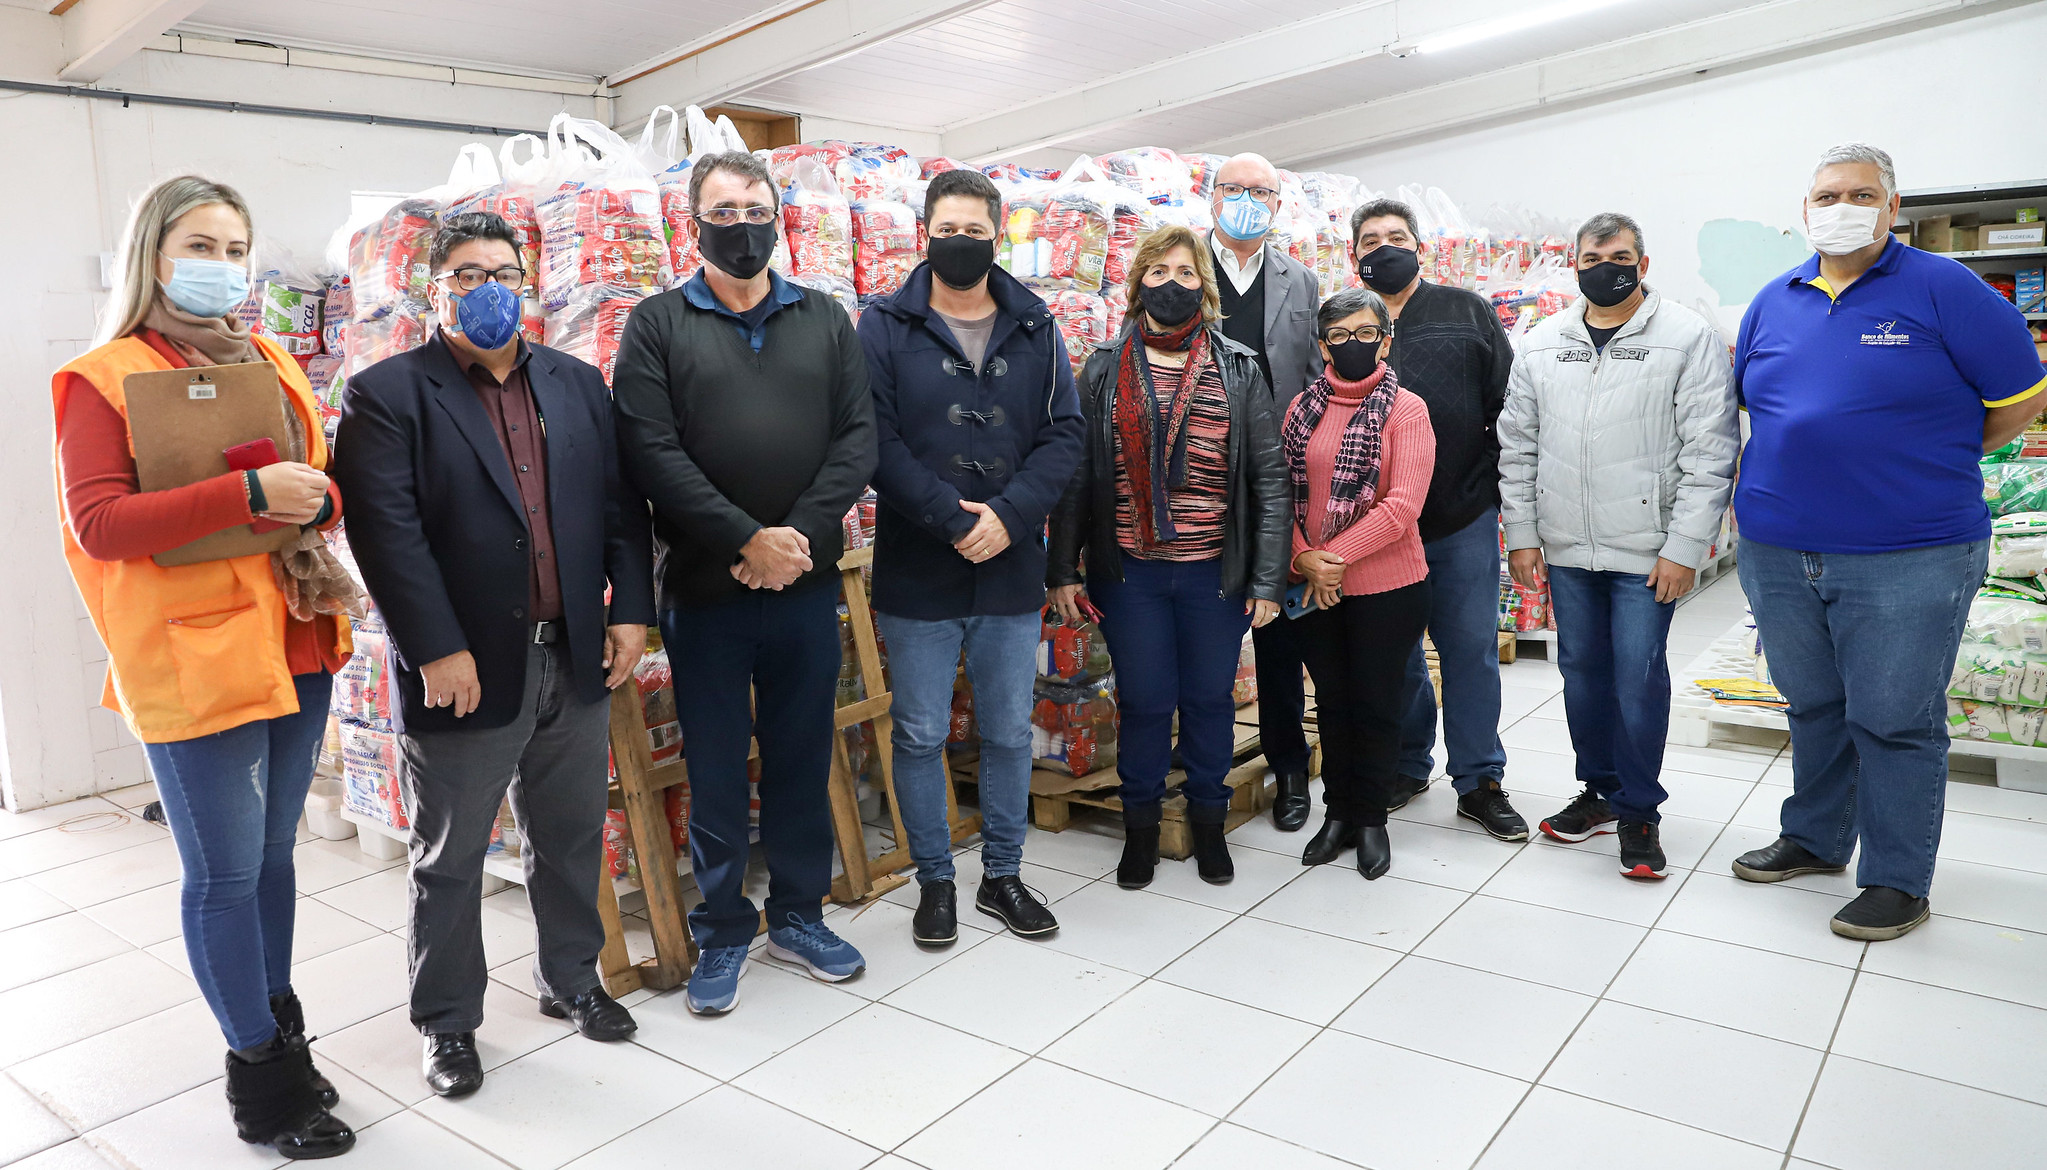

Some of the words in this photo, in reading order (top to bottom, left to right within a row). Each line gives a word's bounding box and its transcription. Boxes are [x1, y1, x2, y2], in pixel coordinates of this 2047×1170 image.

[398, 254, 409, 287] Germani
[1064, 241, 1078, 271] Germani
[869, 259, 879, 290] Germani
[303, 303, 315, 335] CCGL
[1076, 638, 1085, 670] Germani
